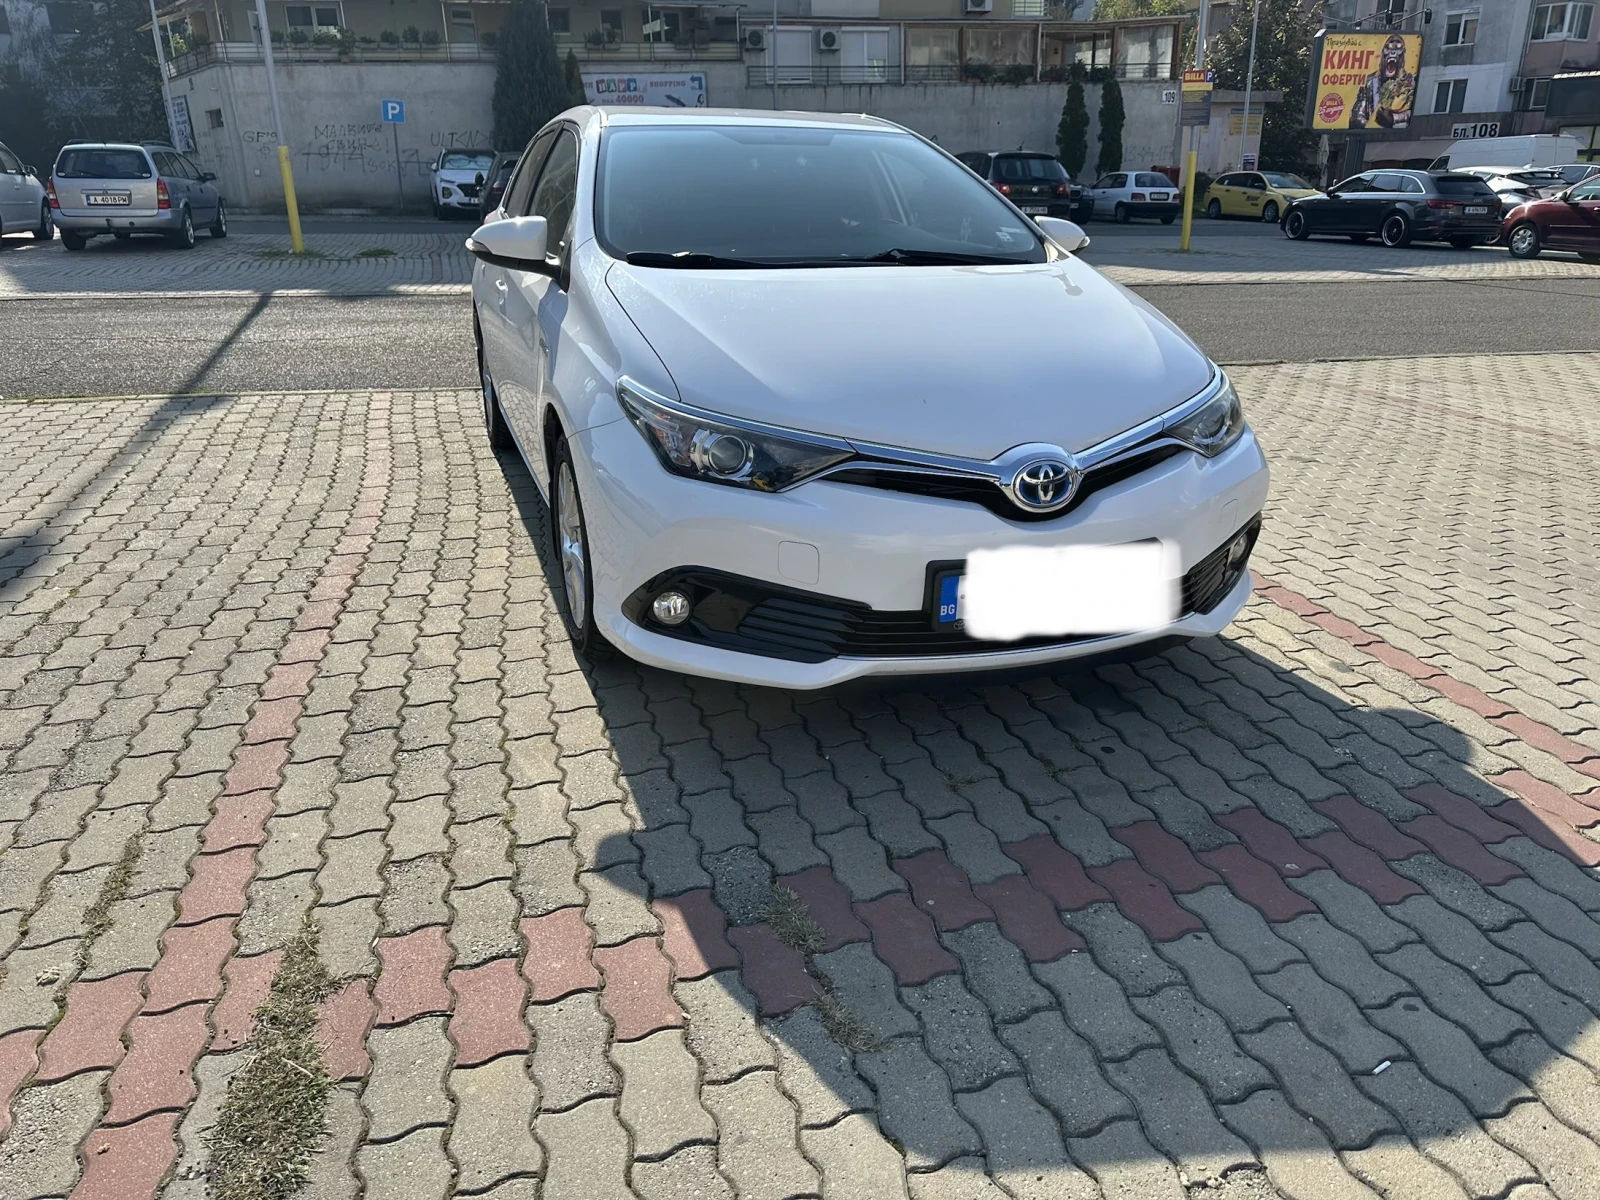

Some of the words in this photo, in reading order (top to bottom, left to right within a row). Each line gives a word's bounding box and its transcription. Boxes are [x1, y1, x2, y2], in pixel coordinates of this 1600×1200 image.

[1324, 50, 1375, 70] КИНГ
[1184, 72, 1205, 81] BILLA
[1207, 71, 1213, 81] P
[1322, 73, 1367, 86] ОФЕРТИ
[649, 80, 686, 88] SHOPPING
[615, 94, 644, 103] 40000
[388, 103, 400, 119] P
[940, 604, 956, 616] BG
